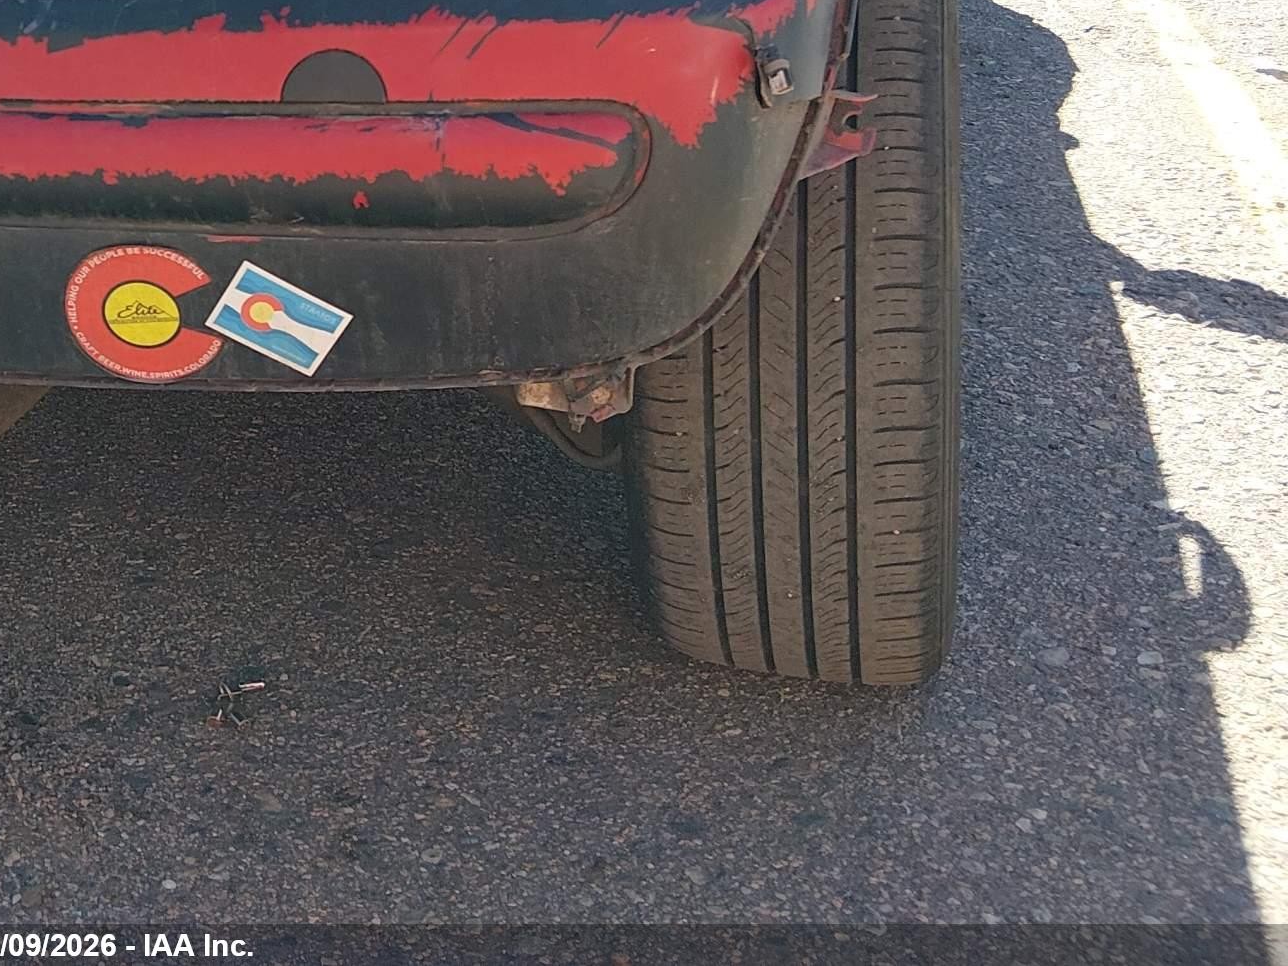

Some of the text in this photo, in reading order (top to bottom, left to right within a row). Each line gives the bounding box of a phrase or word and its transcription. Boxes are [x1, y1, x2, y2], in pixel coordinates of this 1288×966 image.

[67, 246, 206, 323] HELPING OUR PEOPLE BE SUCCESSFUL
[76, 331, 100, 358] CRAFT
